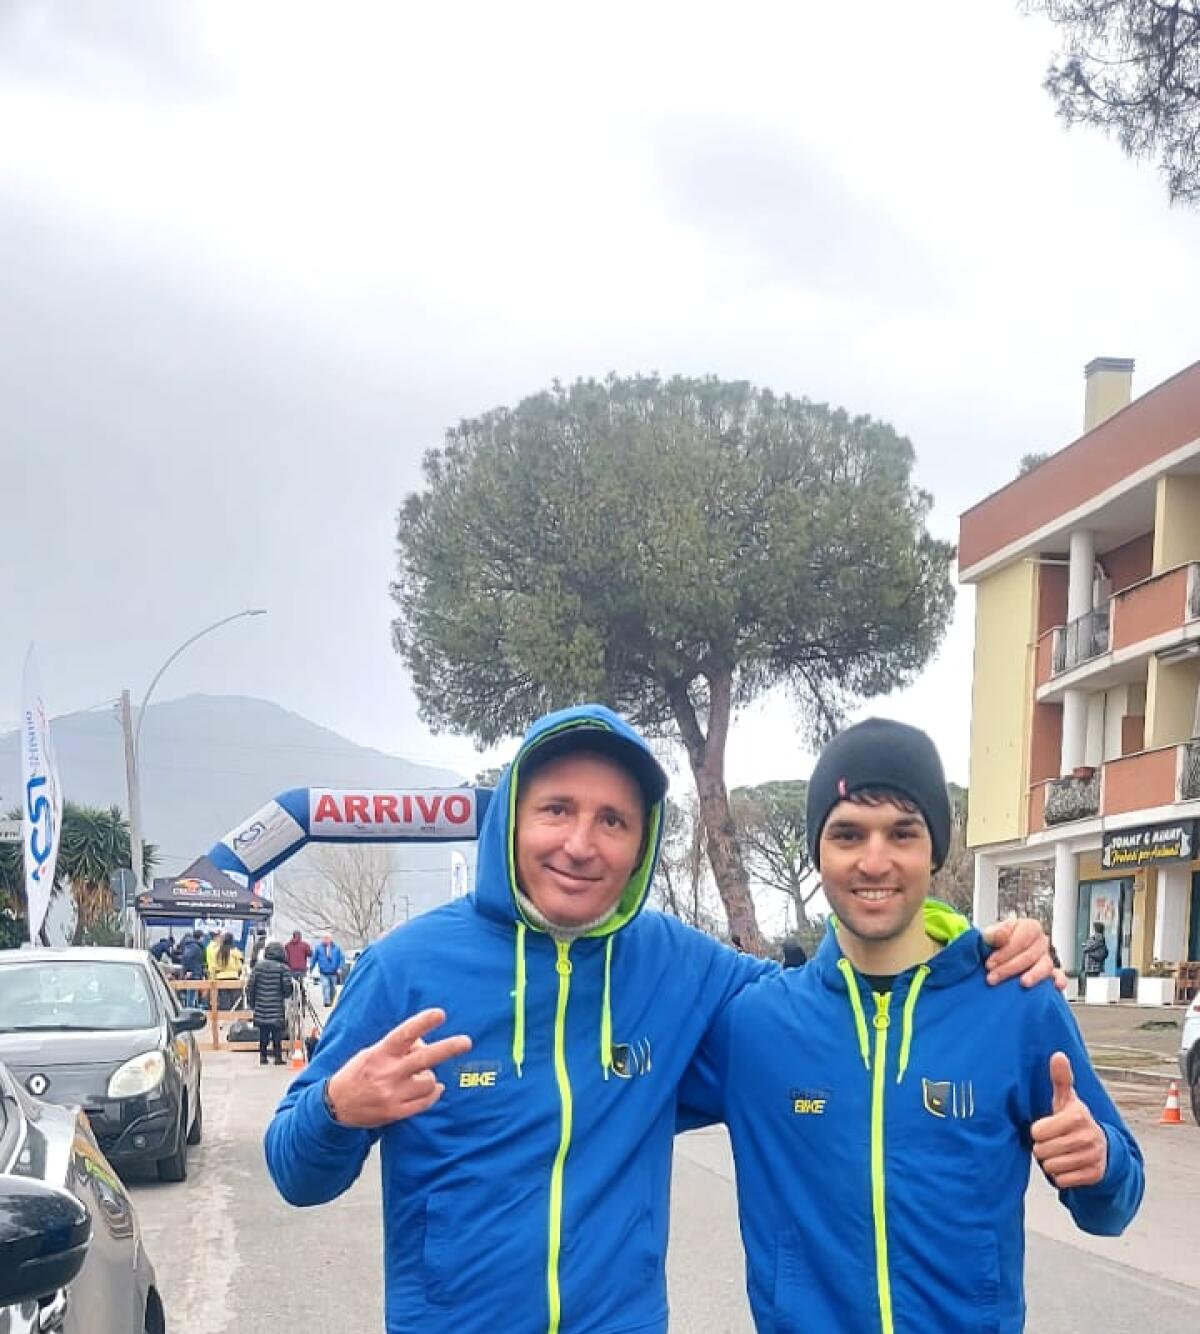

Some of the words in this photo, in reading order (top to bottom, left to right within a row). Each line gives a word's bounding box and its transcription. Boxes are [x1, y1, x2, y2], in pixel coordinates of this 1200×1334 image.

[314, 794, 471, 824] ARRIVO
[459, 1071, 498, 1088] BIKE
[794, 1099, 826, 1114] BIKE
